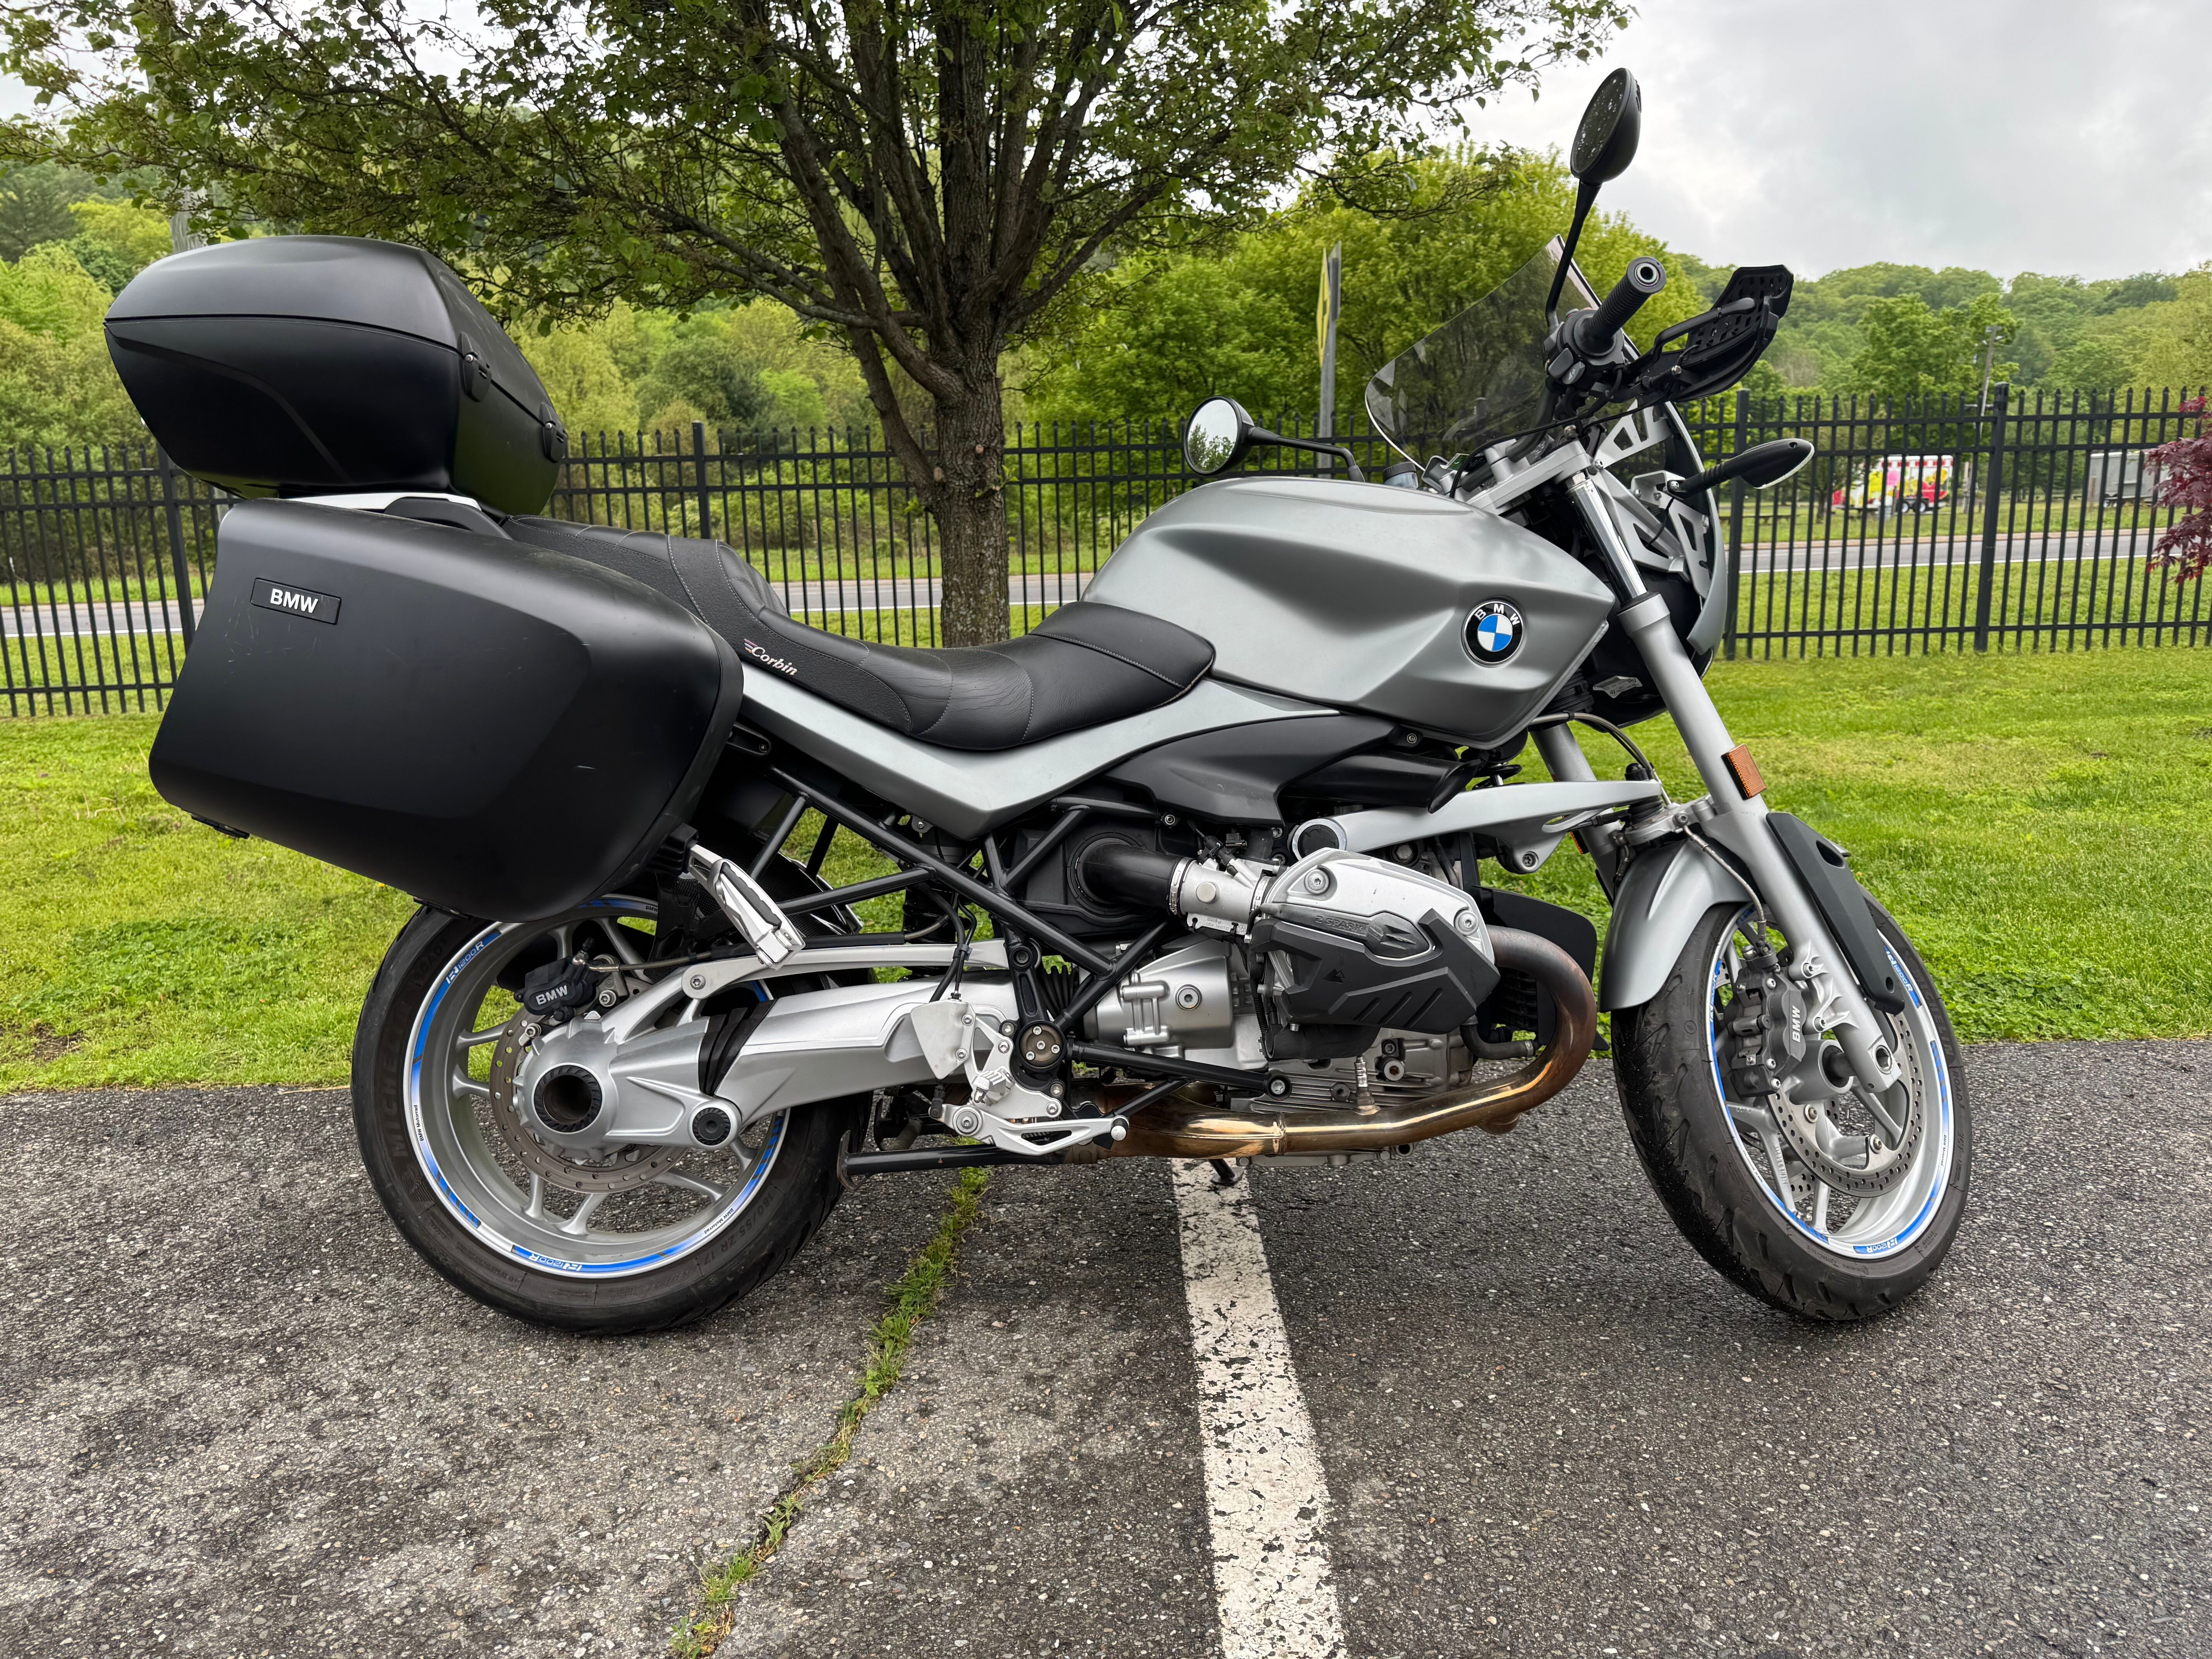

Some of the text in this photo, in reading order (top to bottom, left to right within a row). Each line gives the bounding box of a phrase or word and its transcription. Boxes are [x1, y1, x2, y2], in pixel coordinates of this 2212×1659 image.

[270, 588, 319, 613] BMW
[1474, 603, 1520, 625] BMW
[751, 646, 798, 675] Corbin
[1315, 915, 1364, 933] 2 SPARK
[536, 985, 568, 1005] BMW
[1792, 1005, 1800, 1042] BMW
[1952, 1071, 1963, 1101] ROAD
[704, 1218, 723, 1234] Motorrad
[720, 1238, 738, 1252] ZR
